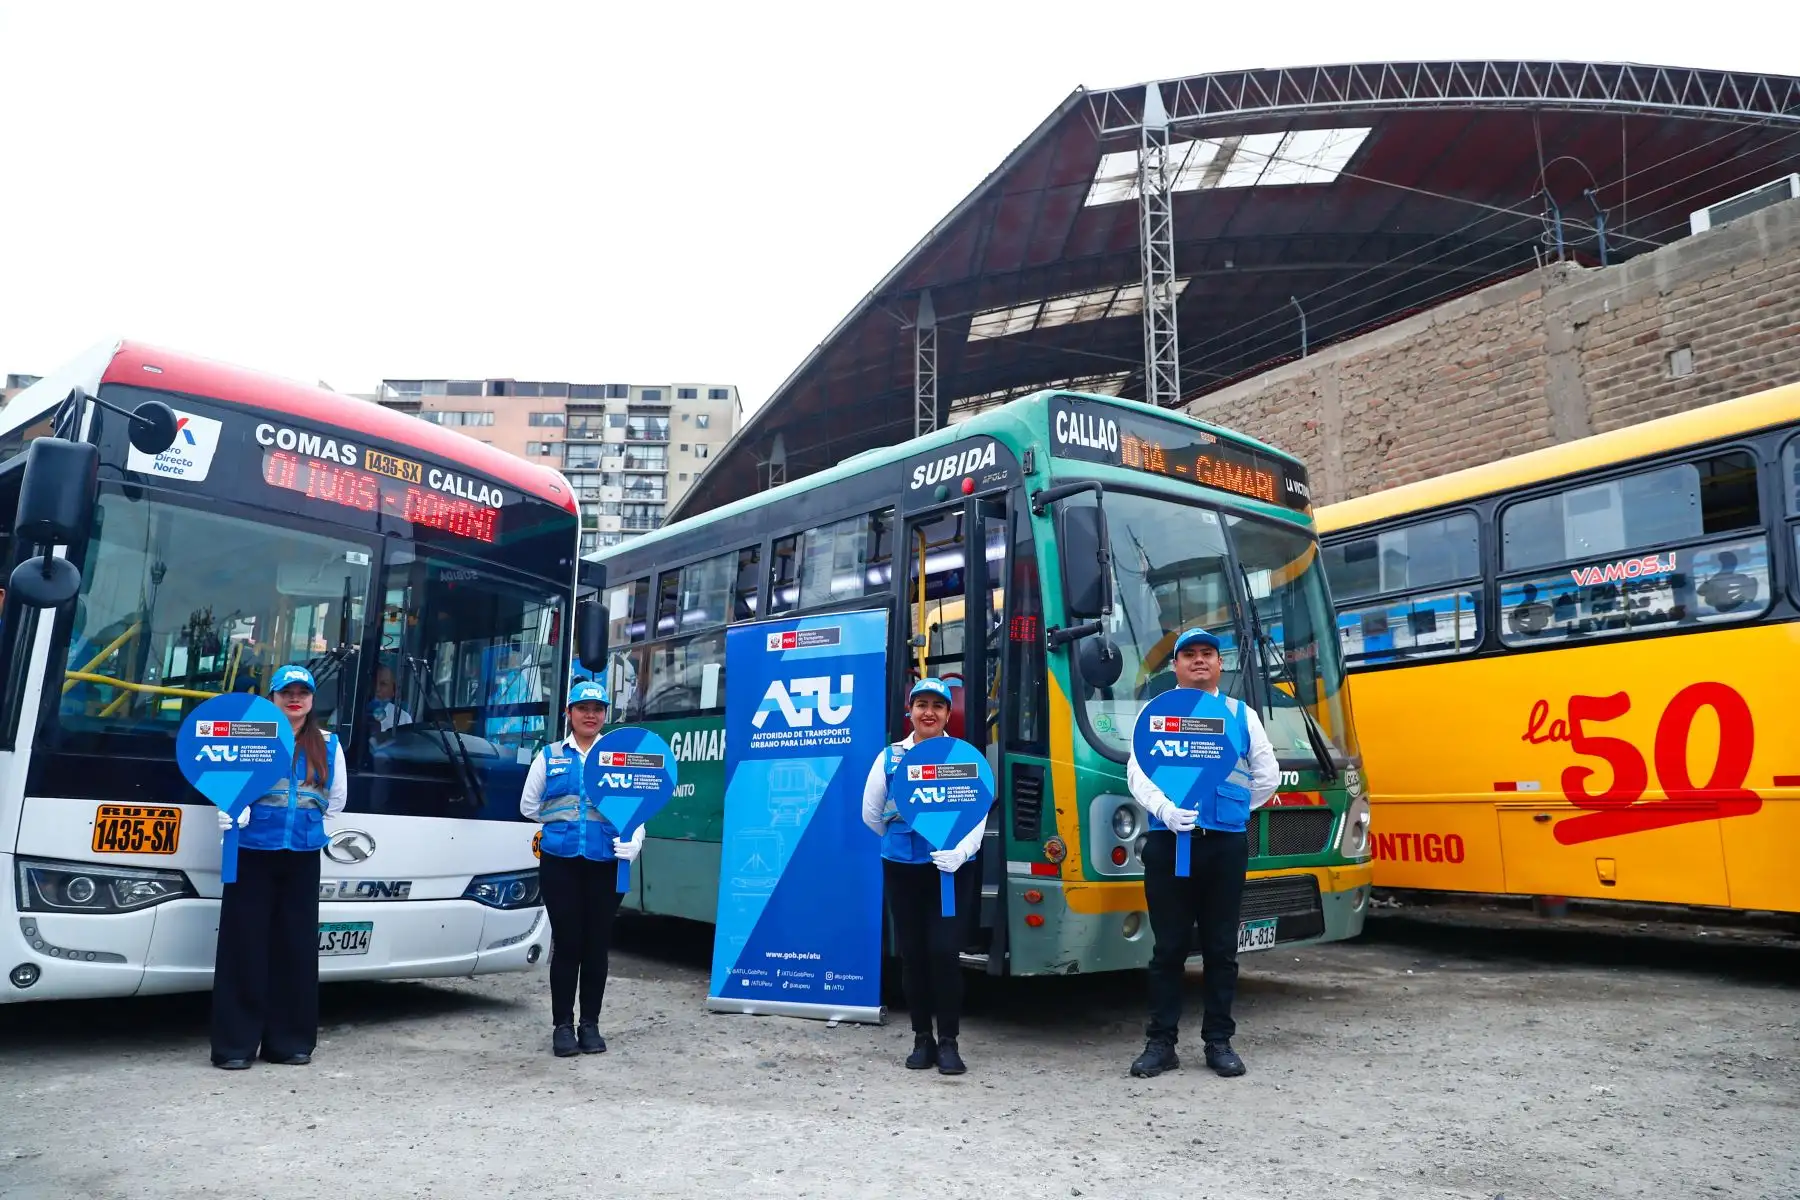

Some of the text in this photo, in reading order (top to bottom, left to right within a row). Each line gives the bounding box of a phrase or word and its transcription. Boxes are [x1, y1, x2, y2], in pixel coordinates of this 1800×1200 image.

[1056, 410, 1118, 453] CALLAO
[164, 446, 181, 455] ero
[255, 423, 357, 465] COMAS
[153, 462, 184, 475] Norte
[155, 453, 193, 468] Directo
[367, 451, 420, 482] 1435-SX
[911, 442, 996, 490] SUBIDA
[428, 468, 504, 508] CALLAO
[752, 674, 854, 729] ATU
[751, 740, 780, 749] URBANO
[781, 739, 798, 747] PARA
[800, 738, 817, 747] LIMA
[824, 736, 852, 745] CALLAO
[752, 731, 793, 740] AUTORIDAD
[805, 728, 850, 738] TRANSPORTE
[195, 744, 239, 762] ATU
[1150, 739, 1189, 758] ATU
[1521, 681, 1755, 812] la 50
[597, 772, 633, 789] ATU
[909, 786, 946, 804] ATU
[101, 806, 177, 818] RUTA
[96, 819, 178, 852] 1435-SX
[1367, 831, 1465, 865] ONTIGO
[338, 880, 412, 900] LONG
[318, 930, 368, 951] LS-014
[1238, 926, 1275, 949] APL-813
[766, 951, 821, 960] www.gob.pe/atu
